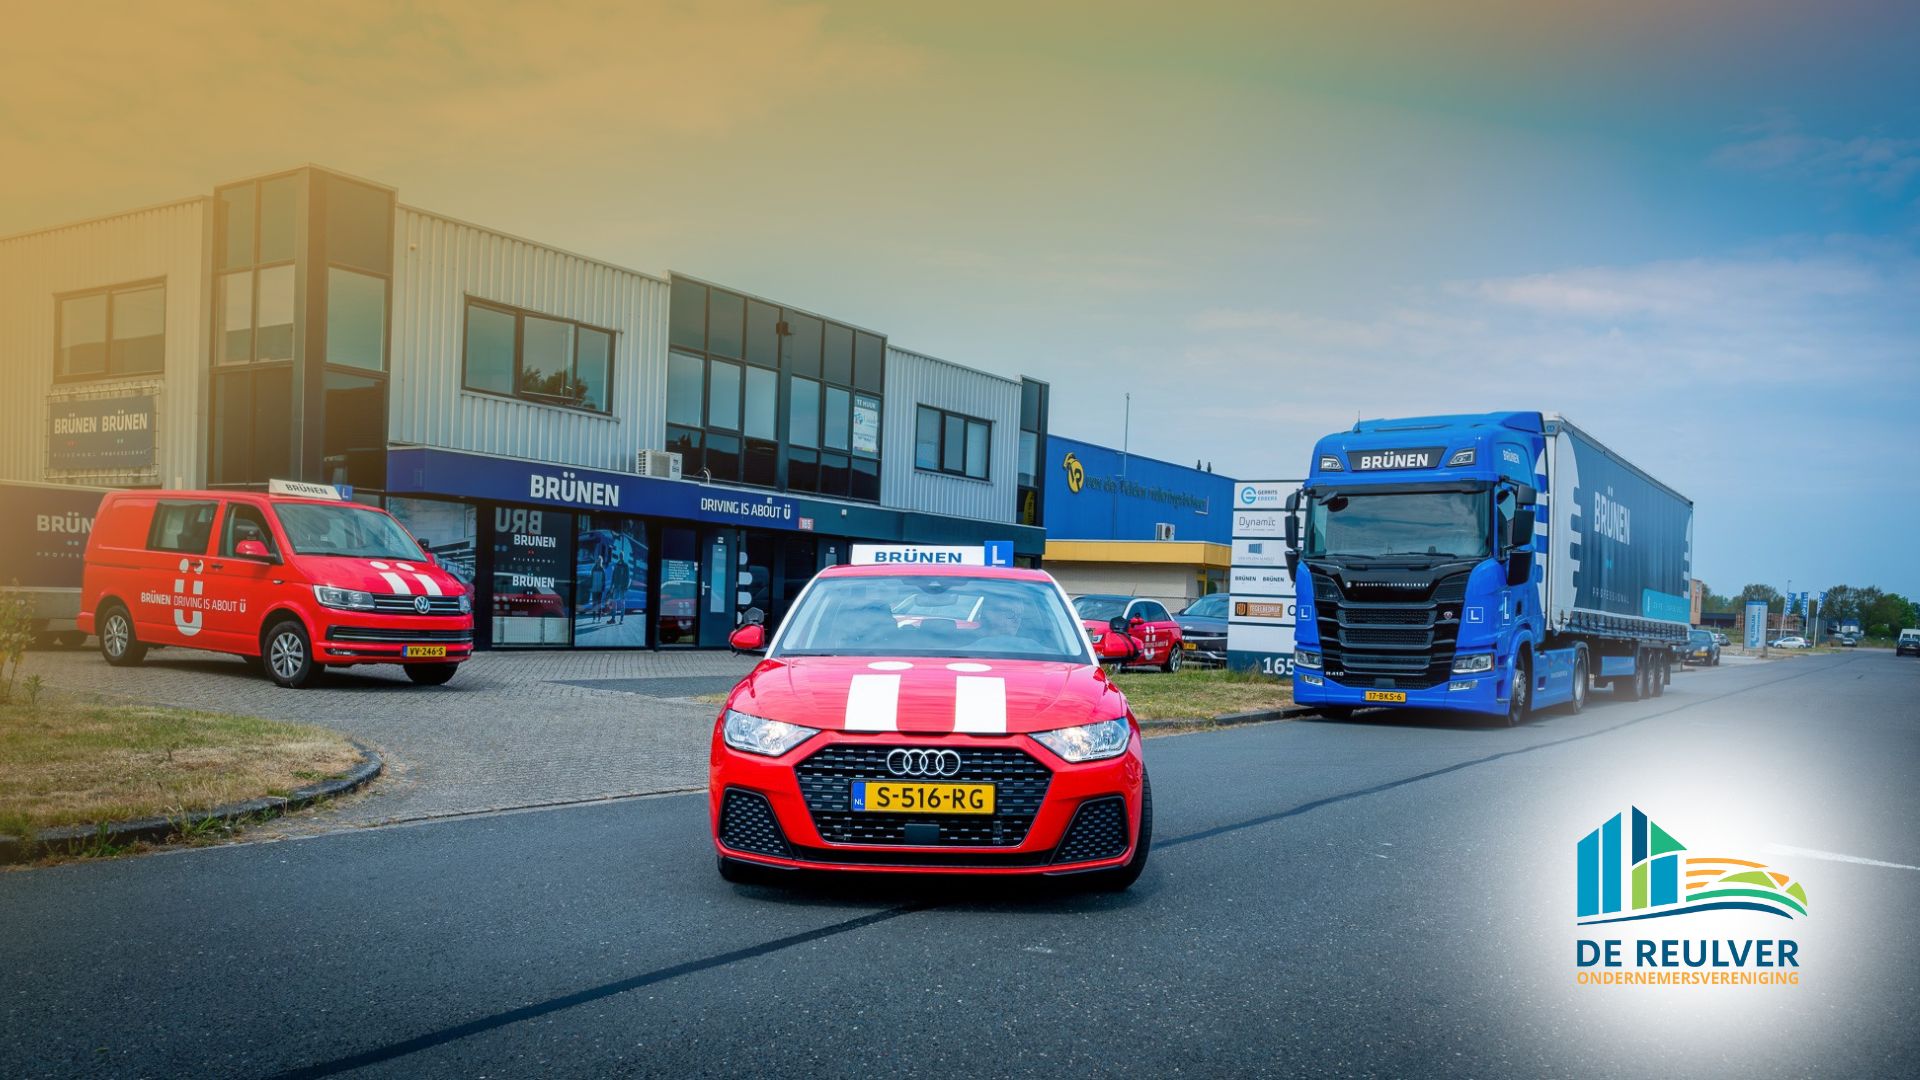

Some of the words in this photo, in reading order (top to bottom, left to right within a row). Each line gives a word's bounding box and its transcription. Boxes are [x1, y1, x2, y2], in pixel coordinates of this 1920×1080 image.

[54, 412, 97, 434] BRÜNEN
[101, 409, 148, 432] BRÜNEN
[1361, 451, 1429, 469] BRÜNEN
[285, 483, 329, 496] BRÜNEN
[530, 471, 620, 507] BRÜNEN
[700, 497, 739, 514] DRIVING
[740, 502, 750, 516] IS
[751, 504, 781, 519] ABOUT
[783, 504, 791, 520] Ü
[1594, 485, 1631, 546] BRÜNEN
[874, 548, 963, 564] BRÜNEN
[992, 545, 1006, 565] L
[512, 572, 555, 589] BRÜNEN
[141, 590, 171, 605] BRÜNEN
[173, 595, 203, 609] DRIVING
[203, 598, 210, 610] IS
[211, 600, 238, 612] ABOUT
[239, 598, 247, 613] Ü
[1301, 608, 1309, 618] L
[1470, 610, 1479, 621] L
[1368, 692, 1402, 701] 17-BKS-6
[854, 798, 864, 806] NL
[876, 786, 984, 809] S-516-RG
